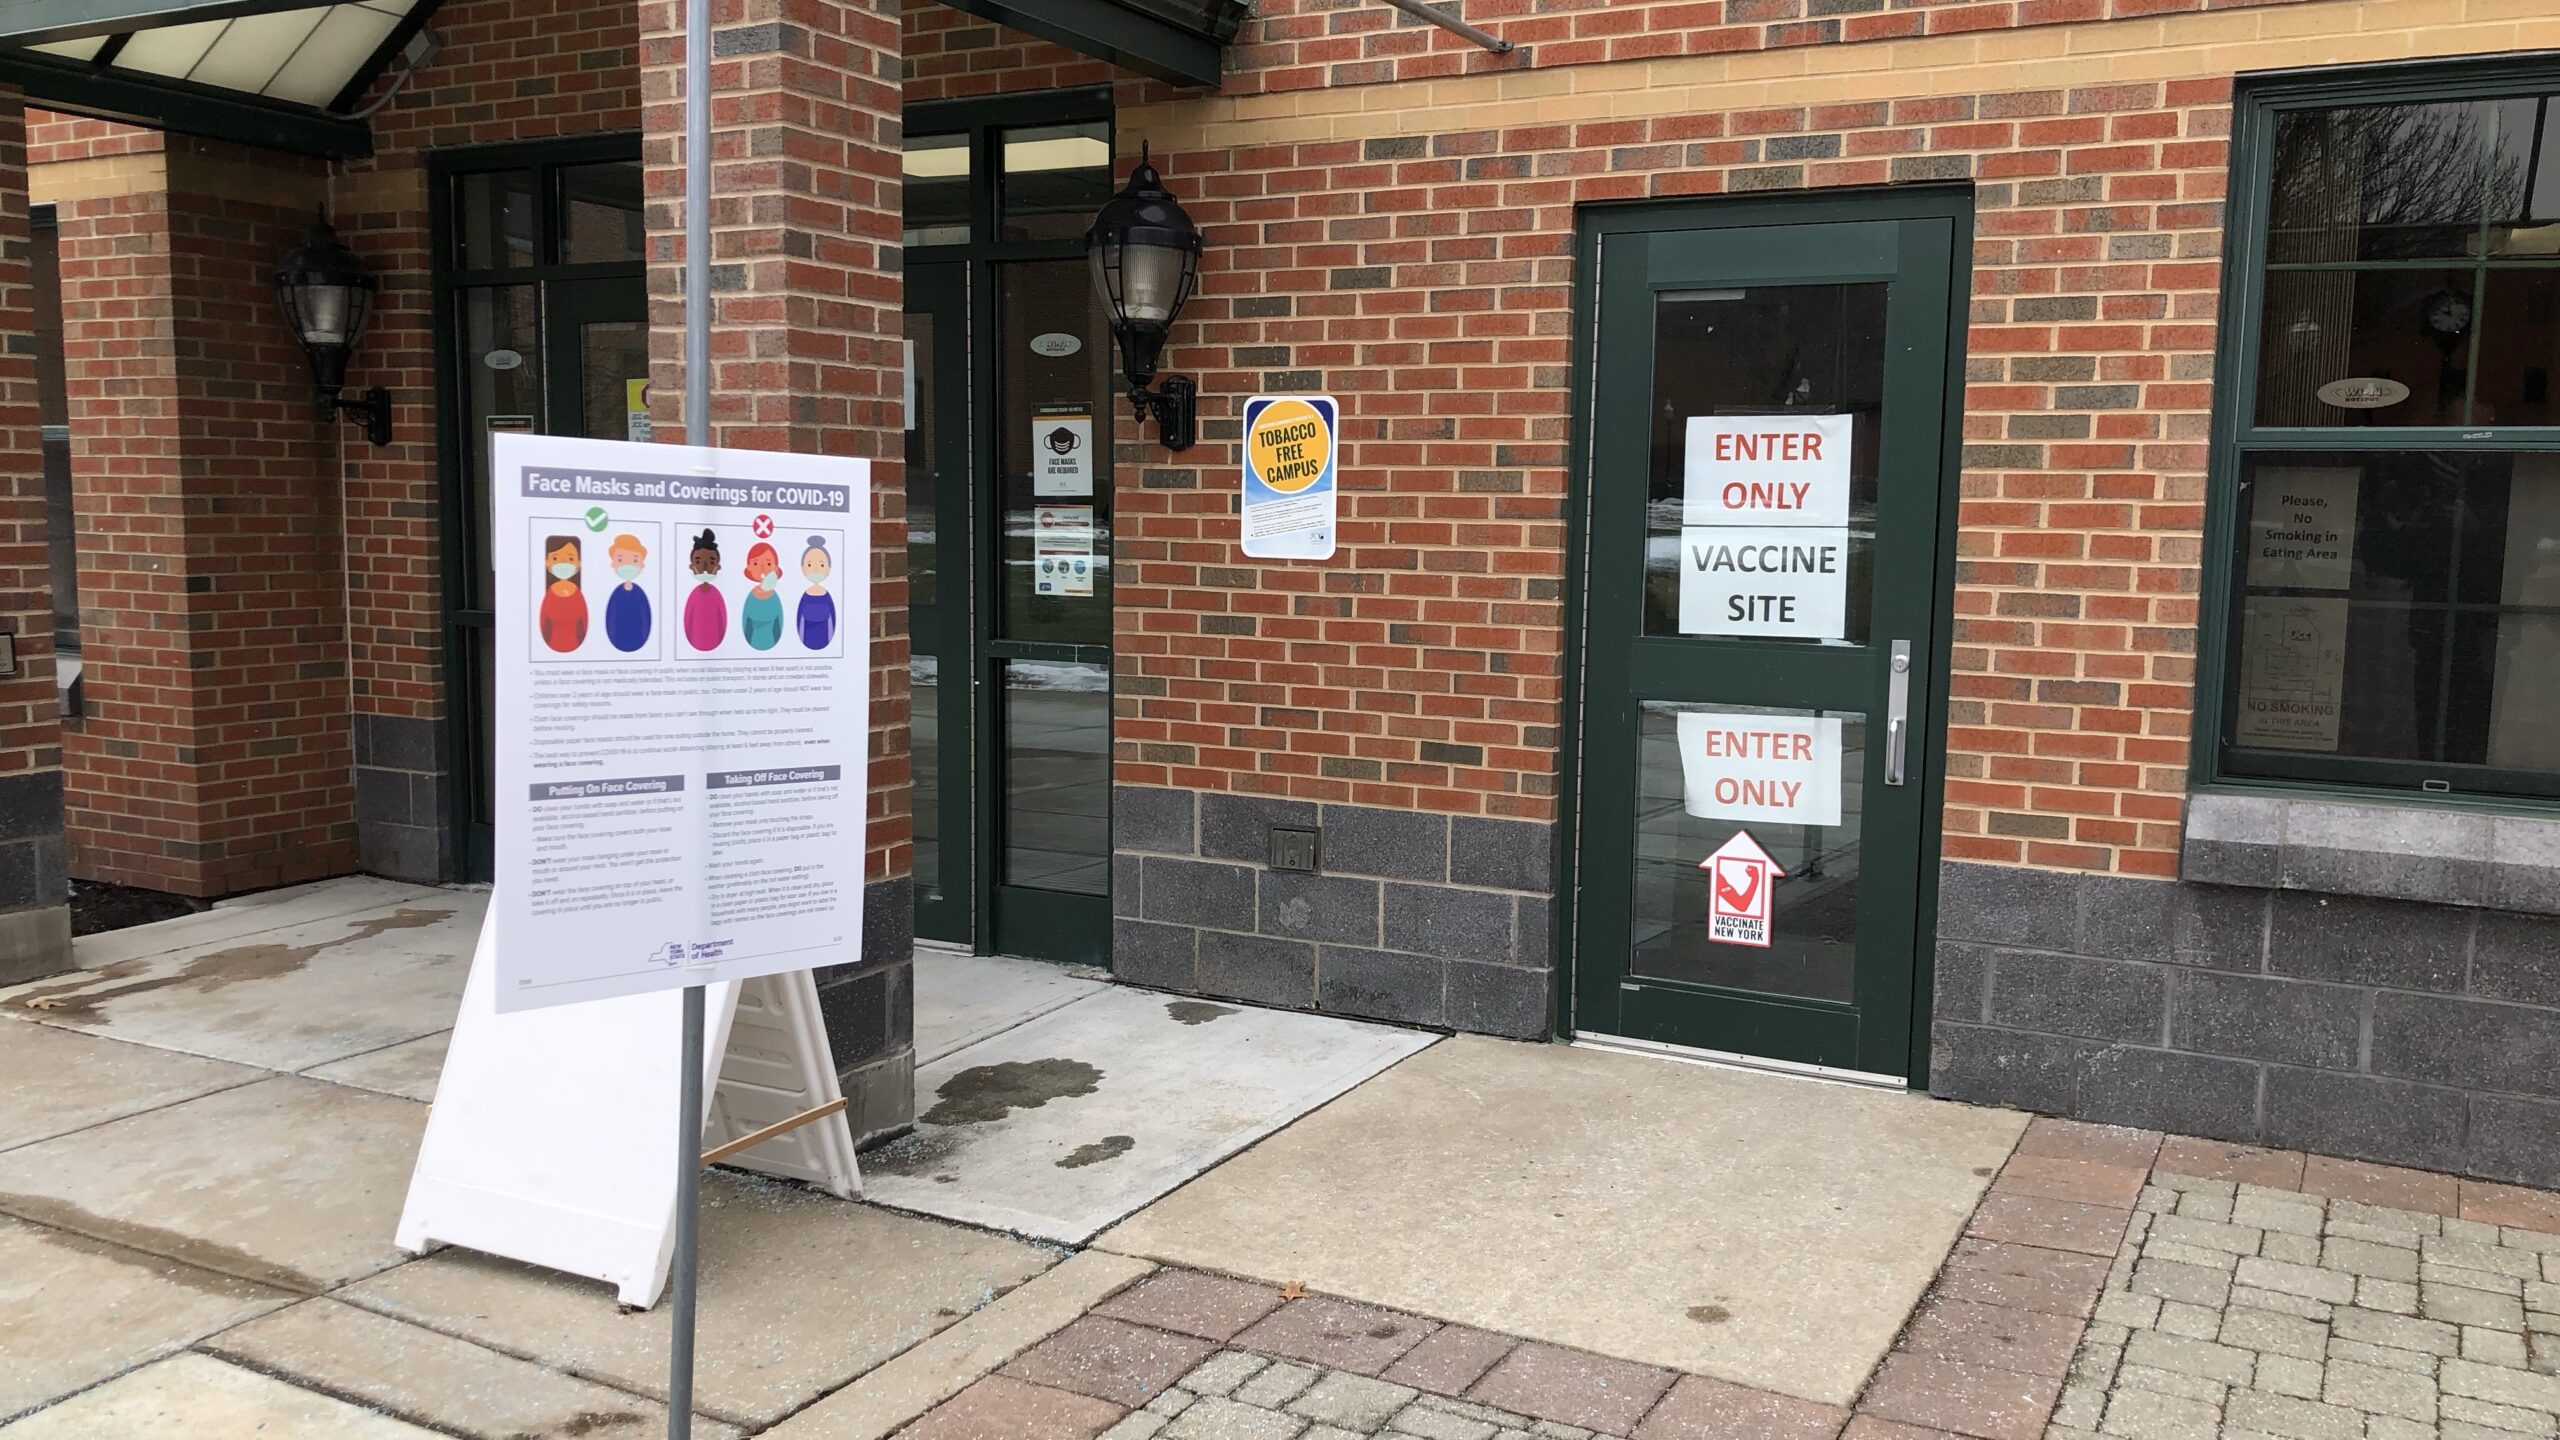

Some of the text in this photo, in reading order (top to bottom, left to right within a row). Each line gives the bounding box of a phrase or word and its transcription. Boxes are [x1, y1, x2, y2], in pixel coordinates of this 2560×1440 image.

[1259, 422, 1316, 448] TOBACCO
[1276, 443, 1304, 463] FREE
[1715, 433, 1823, 461] ENTER
[1048, 466, 1078, 474] ARE REQUIRED
[1049, 458, 1076, 466] FACE MASKS
[1267, 459, 1318, 483] CAMPUS
[529, 473, 844, 508] Face Masks and Coverings for COVID-19
[1722, 482, 1811, 510] ONLY
[2282, 495, 2328, 508] Please,
[2294, 513, 2313, 524] No
[2266, 530, 2338, 544] Smoking in
[1692, 545, 1837, 574] VACCINE
[2262, 547, 2338, 560] Eating Area
[1728, 594, 1796, 623] SITE
[2248, 701, 2334, 716] NO SMOKING
[1706, 730, 1813, 761] ENTER
[725, 769, 824, 786] Taking Off Face Covering
[549, 780, 667, 796] Putting On Face Covering
[1714, 777, 1803, 808] ONLY
[1715, 916, 1764, 931] VACCINATE
[1714, 926, 1764, 942] NEW YORK
[691, 938, 734, 951] Department
[691, 949, 723, 960] of Health
